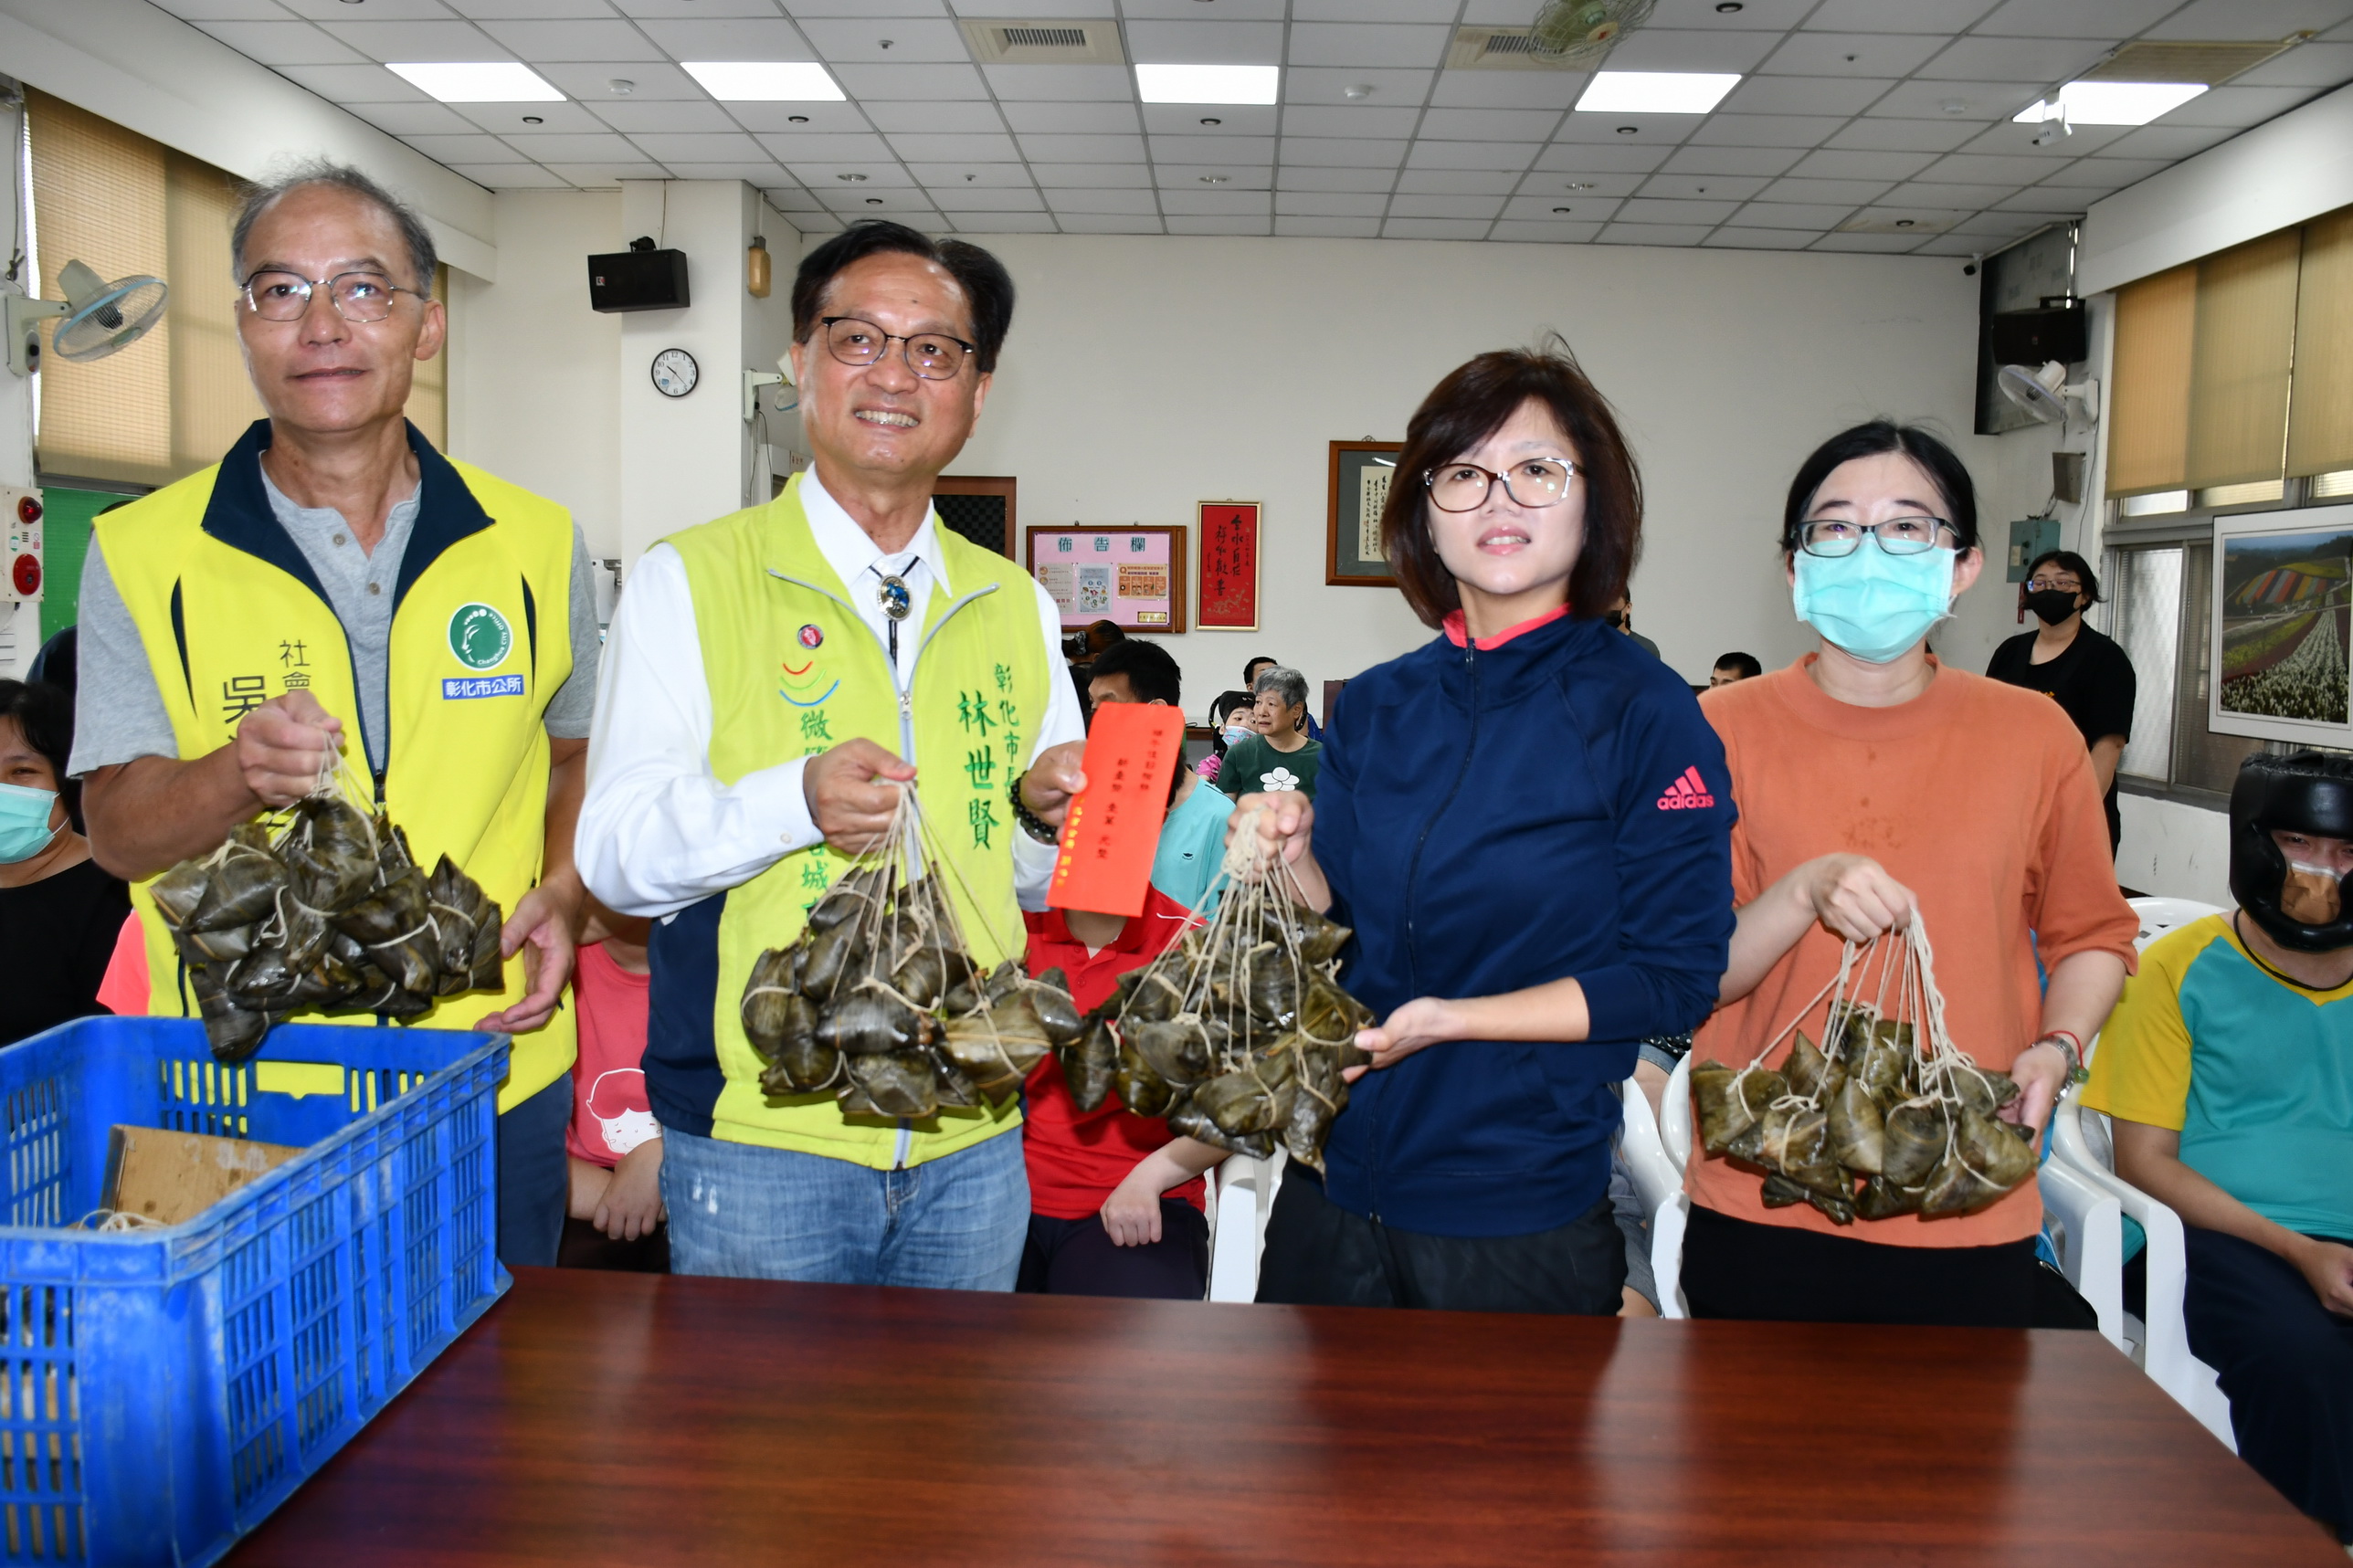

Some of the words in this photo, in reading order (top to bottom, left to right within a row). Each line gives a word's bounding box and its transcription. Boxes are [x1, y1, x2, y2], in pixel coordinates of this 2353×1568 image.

[1058, 536, 1145, 552] 佈告欄
[445, 677, 522, 697] 彰化市公所
[957, 689, 1000, 851] 林世賢
[1656, 794, 1715, 811] adidas
